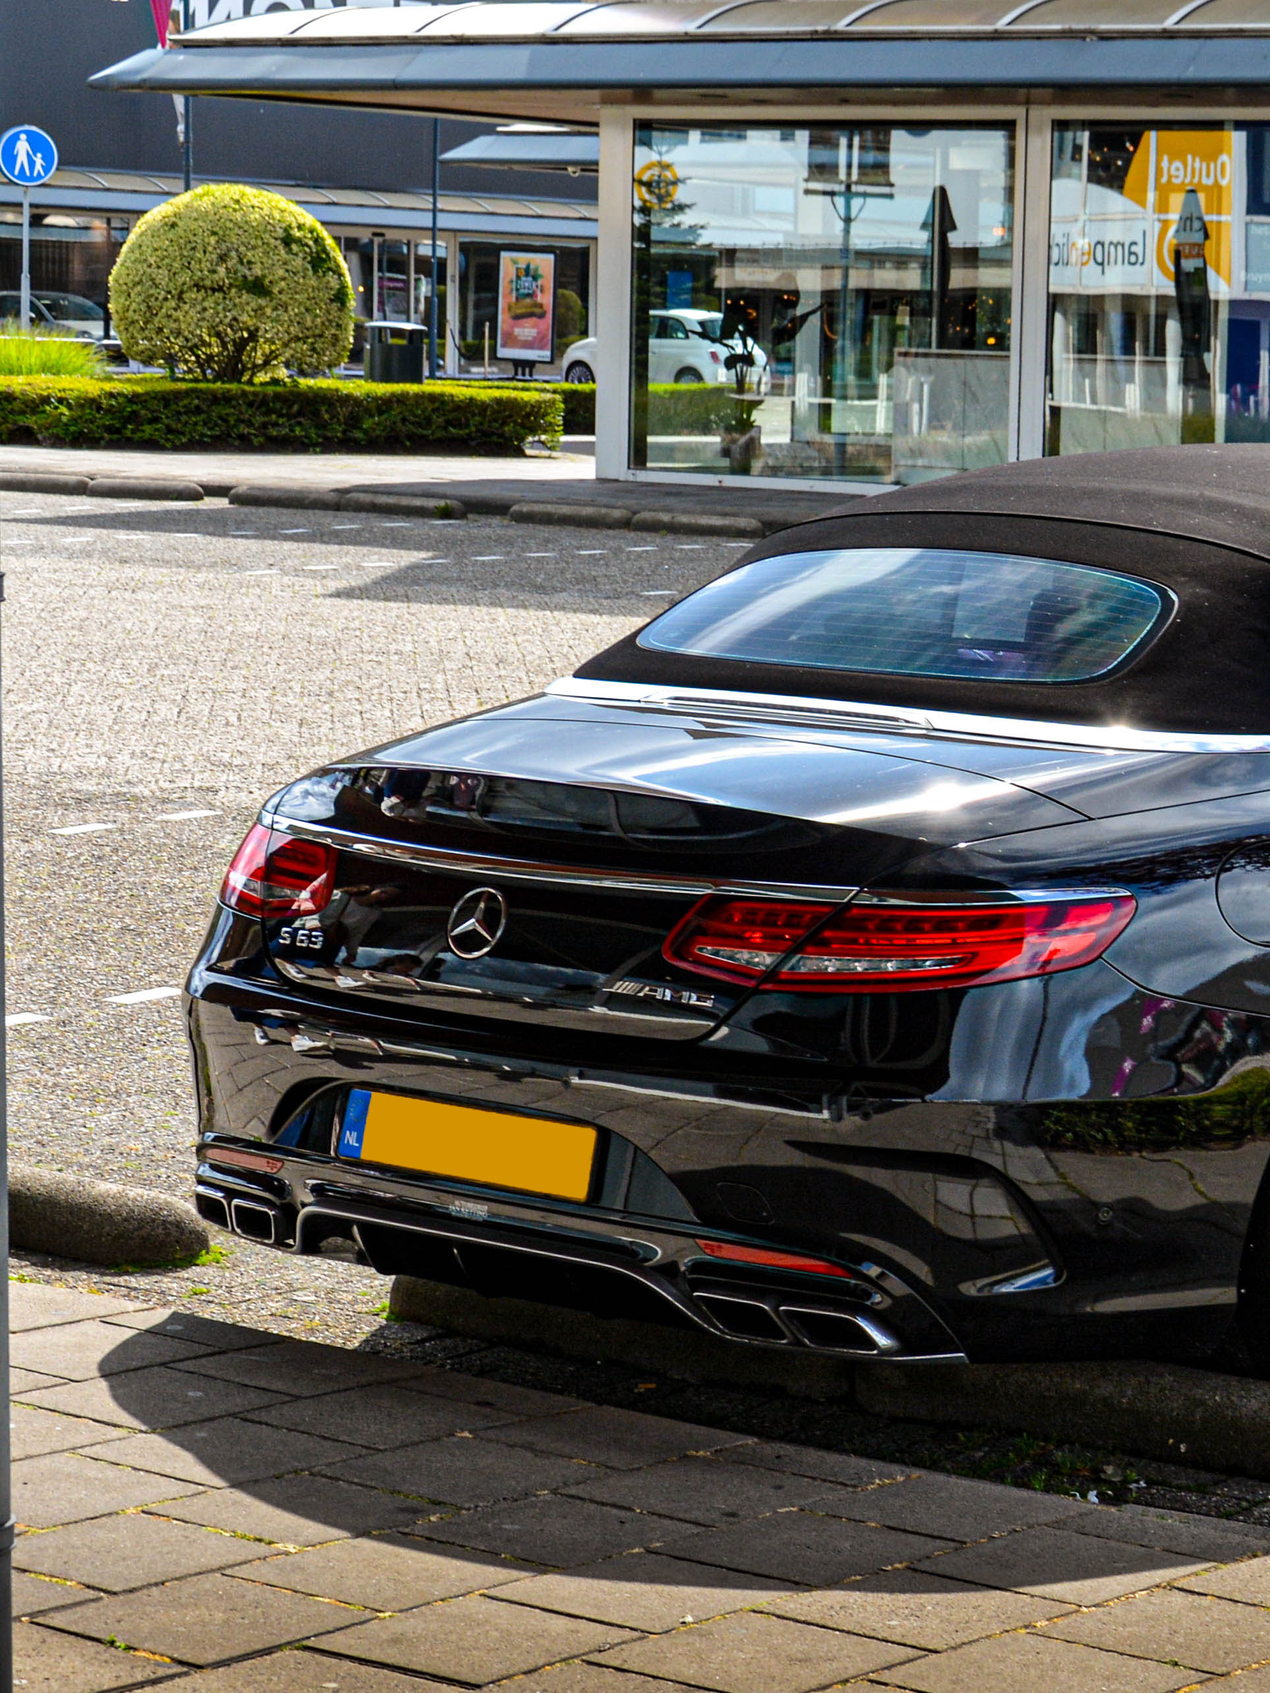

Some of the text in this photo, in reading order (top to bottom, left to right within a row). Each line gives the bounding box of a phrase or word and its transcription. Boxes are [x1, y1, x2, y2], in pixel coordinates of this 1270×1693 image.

[279, 927, 324, 949] S 63
[344, 1129, 359, 1147] NL
